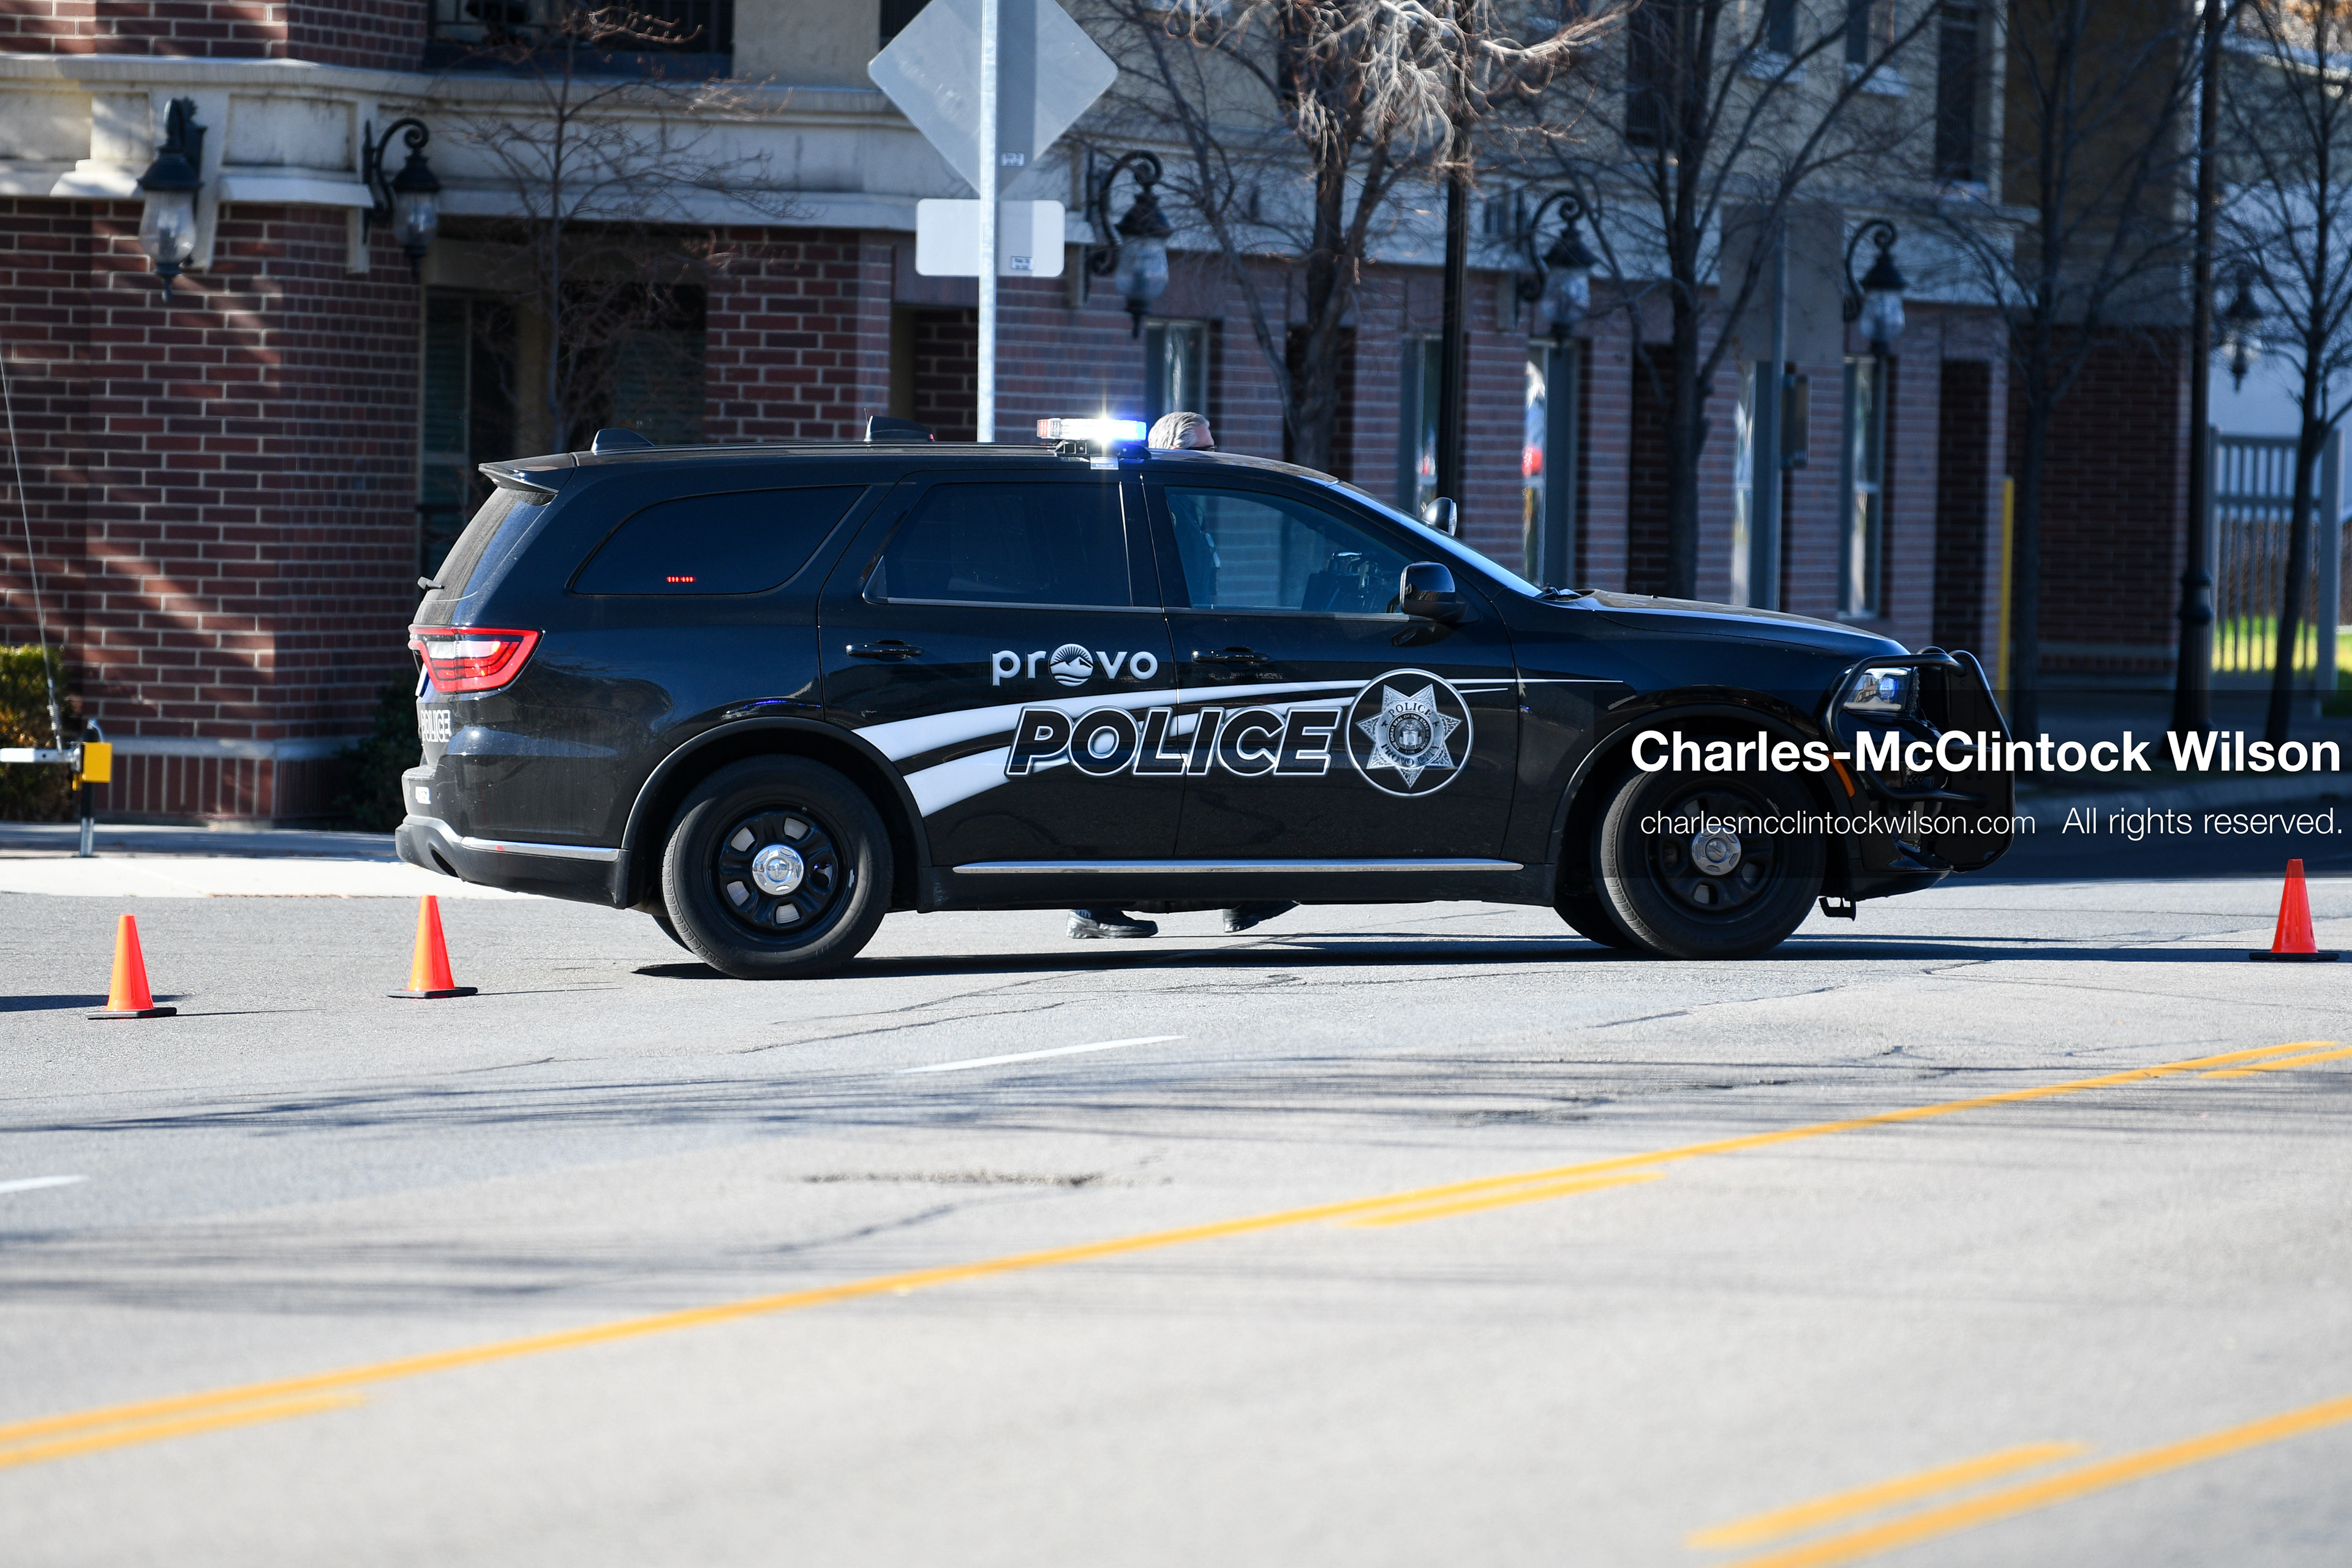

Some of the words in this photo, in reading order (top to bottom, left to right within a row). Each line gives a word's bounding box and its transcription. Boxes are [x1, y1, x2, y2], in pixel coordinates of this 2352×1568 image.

[1389, 703, 1433, 718] POLICE
[420, 710, 451, 742] POLICE
[1005, 706, 1344, 777] POLICE
[1381, 744, 1415, 766] PROVO
